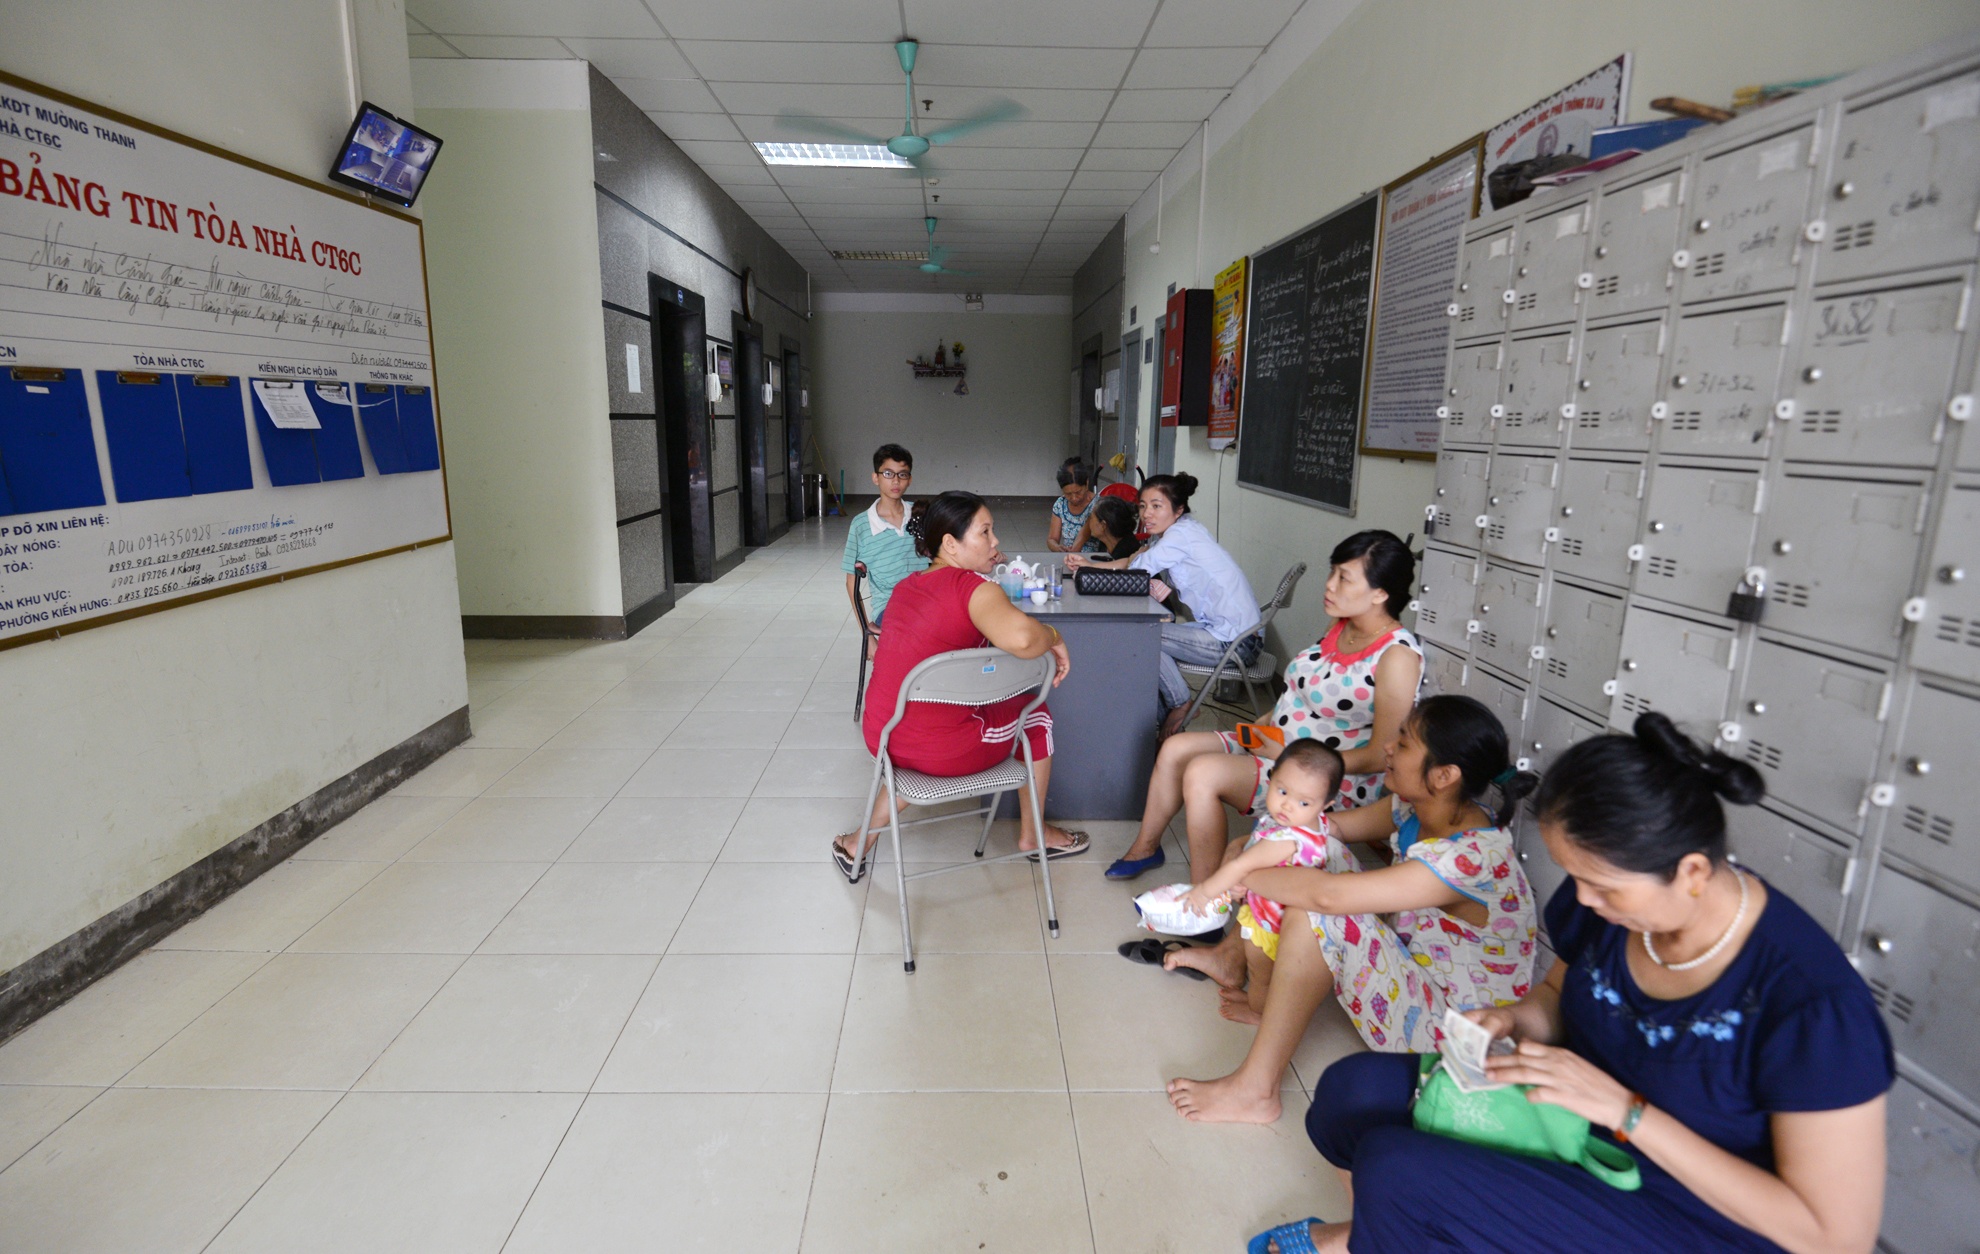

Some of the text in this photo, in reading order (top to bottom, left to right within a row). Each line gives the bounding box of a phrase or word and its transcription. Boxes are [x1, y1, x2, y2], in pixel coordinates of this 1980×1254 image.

[35, 105, 90, 135] MƯỜNG
[93, 125, 137, 150] THANH
[25, 127, 62, 149] CT6C
[0, 151, 362, 276] BẢNG TIN TÒA NHÀ CT6C
[133, 352, 205, 369] TÒA NHÀ CT6C
[258, 361, 338, 378] KIẾN NGHỊ CÁC HỘ DÂN
[369, 370, 414, 381] THÔNG TIN KHÁC
[13, 522, 33, 536] ĐỠ
[36, 521, 59, 533] XIN
[62, 516, 88, 529] LIÊN
[91, 513, 110, 527] HỆ:
[23, 539, 61, 553] NÓNG:
[3, 560, 33, 574] TÒA:
[16, 595, 41, 608] KHU
[43, 590, 71, 603] VỰC:
[0, 598, 113, 630] PHƯỜNG KIẾN HƯNG:
